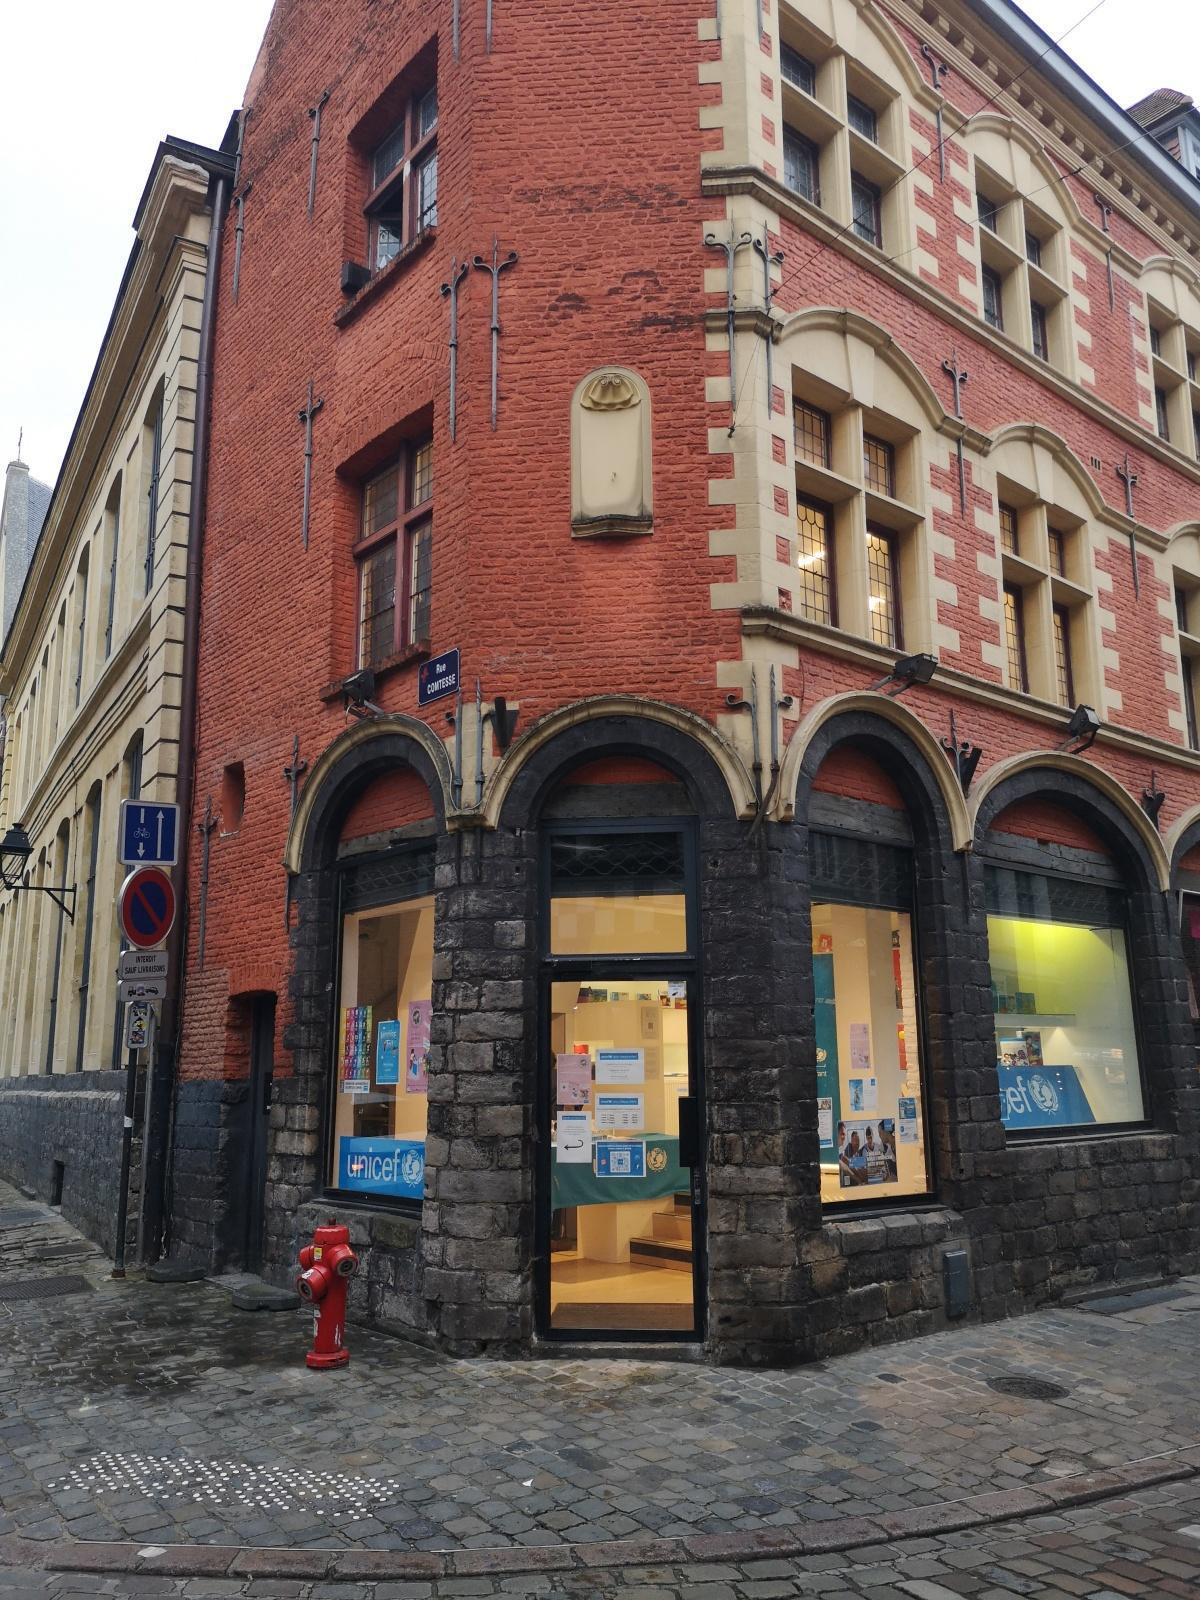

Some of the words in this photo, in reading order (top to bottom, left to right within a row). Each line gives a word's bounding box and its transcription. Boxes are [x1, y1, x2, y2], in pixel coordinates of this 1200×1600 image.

[436, 664, 447, 674] Rue
[427, 673, 456, 695] COMTESSE
[136, 955, 156, 963] INTERDIT
[125, 966, 136, 974] SAUF
[137, 965, 166, 973] LIVRAISONS
[347, 1146, 401, 1182] unicef
